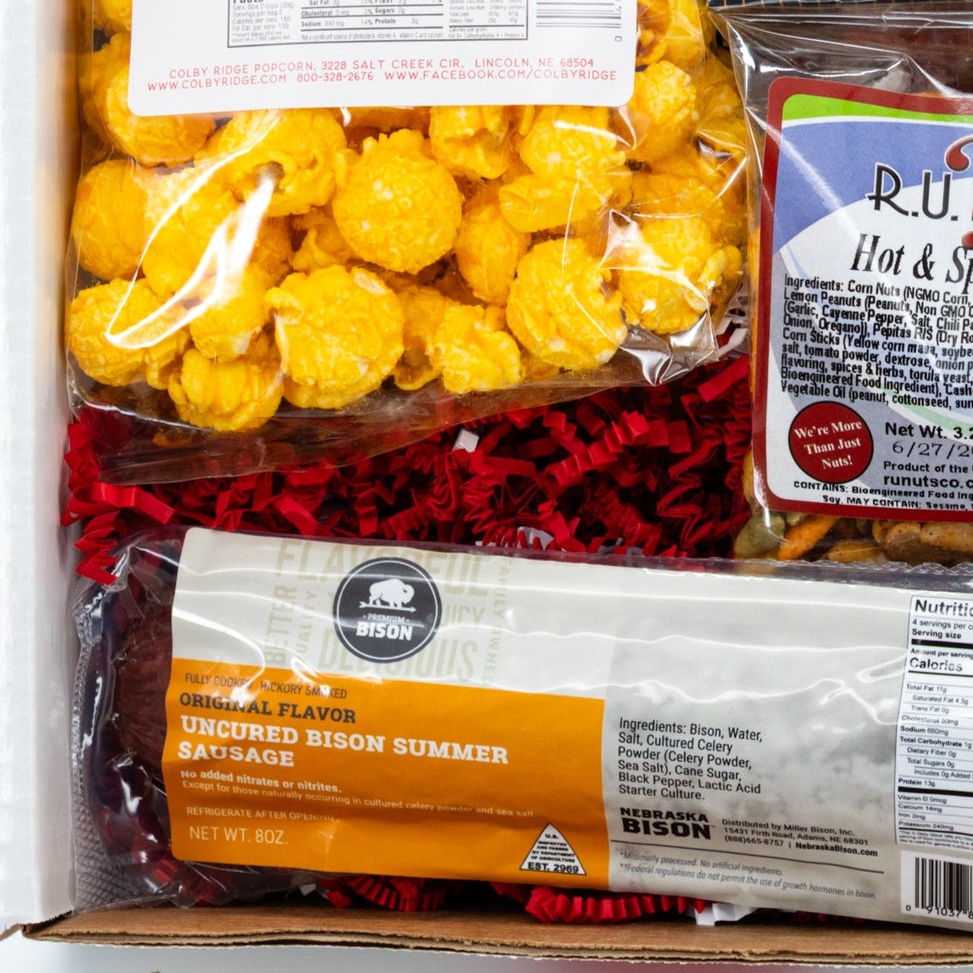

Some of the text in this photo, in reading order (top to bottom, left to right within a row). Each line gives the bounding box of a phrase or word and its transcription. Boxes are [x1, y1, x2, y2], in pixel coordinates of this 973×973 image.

[169, 68, 210, 80] COLBY
[213, 65, 249, 77] RIDGE
[322, 61, 348, 72] 3228
[353, 59, 385, 70] SALT
[390, 59, 435, 69] CREEK
[538, 57, 554, 68] NE
[559, 57, 594, 67] 68504
[147, 69, 617, 91] WWW.COLBYRIDGE.COM 800-328-2676 WWW.FACEBOOK.COM/COLBYRIDGE
[867, 163, 958, 221] R.U.
[849, 233, 905, 275] Hot
[914, 243, 935, 280] &
[794, 420, 862, 439] We're More
[885, 422, 914, 437] Net
[919, 425, 947, 439] Wt.
[804, 438, 861, 455] Than Just
[821, 456, 853, 469] Nuts!
[884, 461, 930, 472] Product
[935, 463, 945, 473] of
[950, 464, 968, 473] the
[368, 613, 405, 624] PREMIUM
[356, 622, 413, 640] BISON
[910, 657, 963, 672] Calories
[179, 693, 356, 724] ORIGINAL FLAVOR
[180, 715, 509, 764] UNCURED BISON SUMMER
[620, 717, 762, 743] Ingredients: Bison, Water,
[618, 732, 732, 755] Salt, Cultured Celery
[177, 741, 295, 767] SAUSAGE
[618, 746, 752, 770] Powder (Celery Powder,
[618, 760, 742, 782] Sea Salt), Cane Sugar,
[618, 772, 761, 794] Black Pepper, Lactic Acid
[619, 784, 705, 800] Starter Culture.
[620, 807, 709, 822] NEBRASKA
[190, 827, 288, 845] NET WT. 8OZ.
[622, 818, 712, 840] BISON
[795, 842, 878, 857] NebraskaBison.com
[528, 862, 550, 871] EST.
